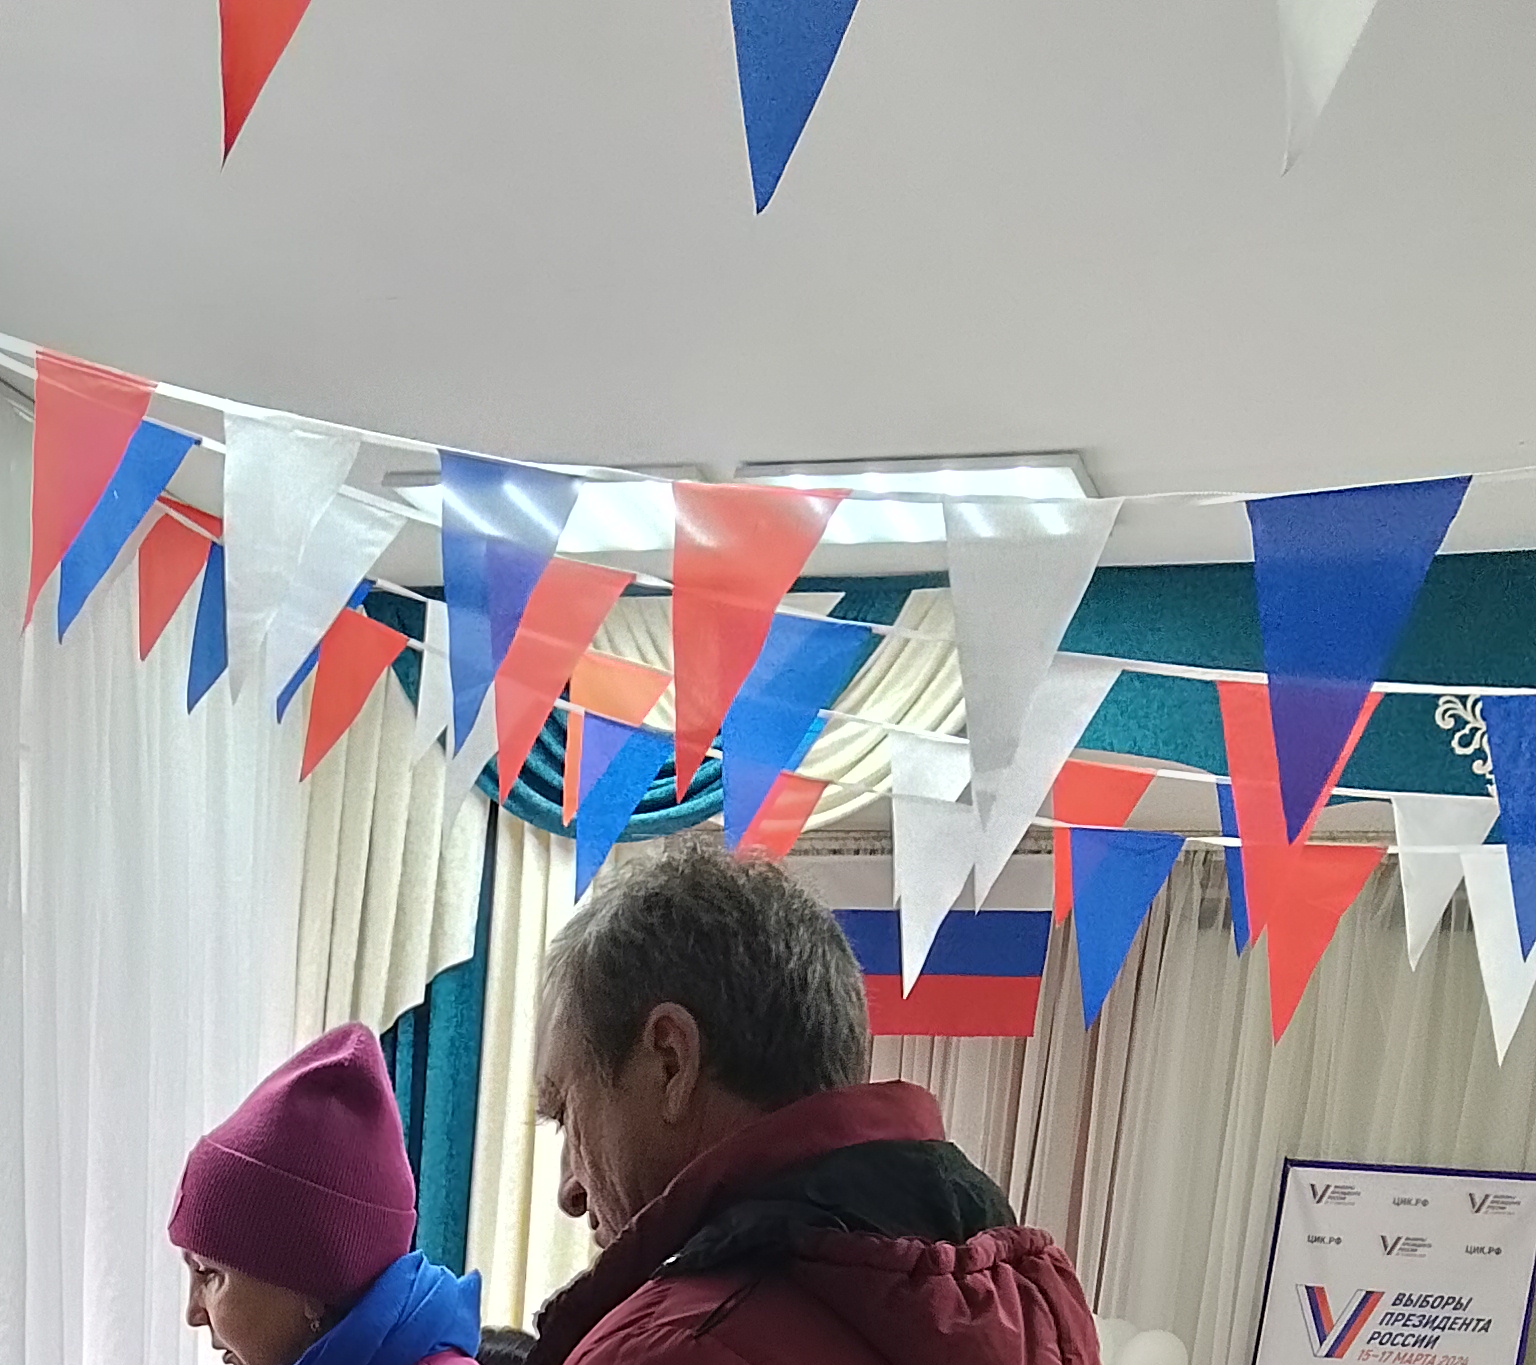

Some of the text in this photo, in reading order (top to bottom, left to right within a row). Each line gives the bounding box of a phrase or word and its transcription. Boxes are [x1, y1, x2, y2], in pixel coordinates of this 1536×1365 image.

[1391, 1292, 1473, 1312] ВЫБОРЫ
[1379, 1312, 1493, 1334] ПРЕЗИДЕНТА
[1366, 1330, 1440, 1350] РОССИИ
